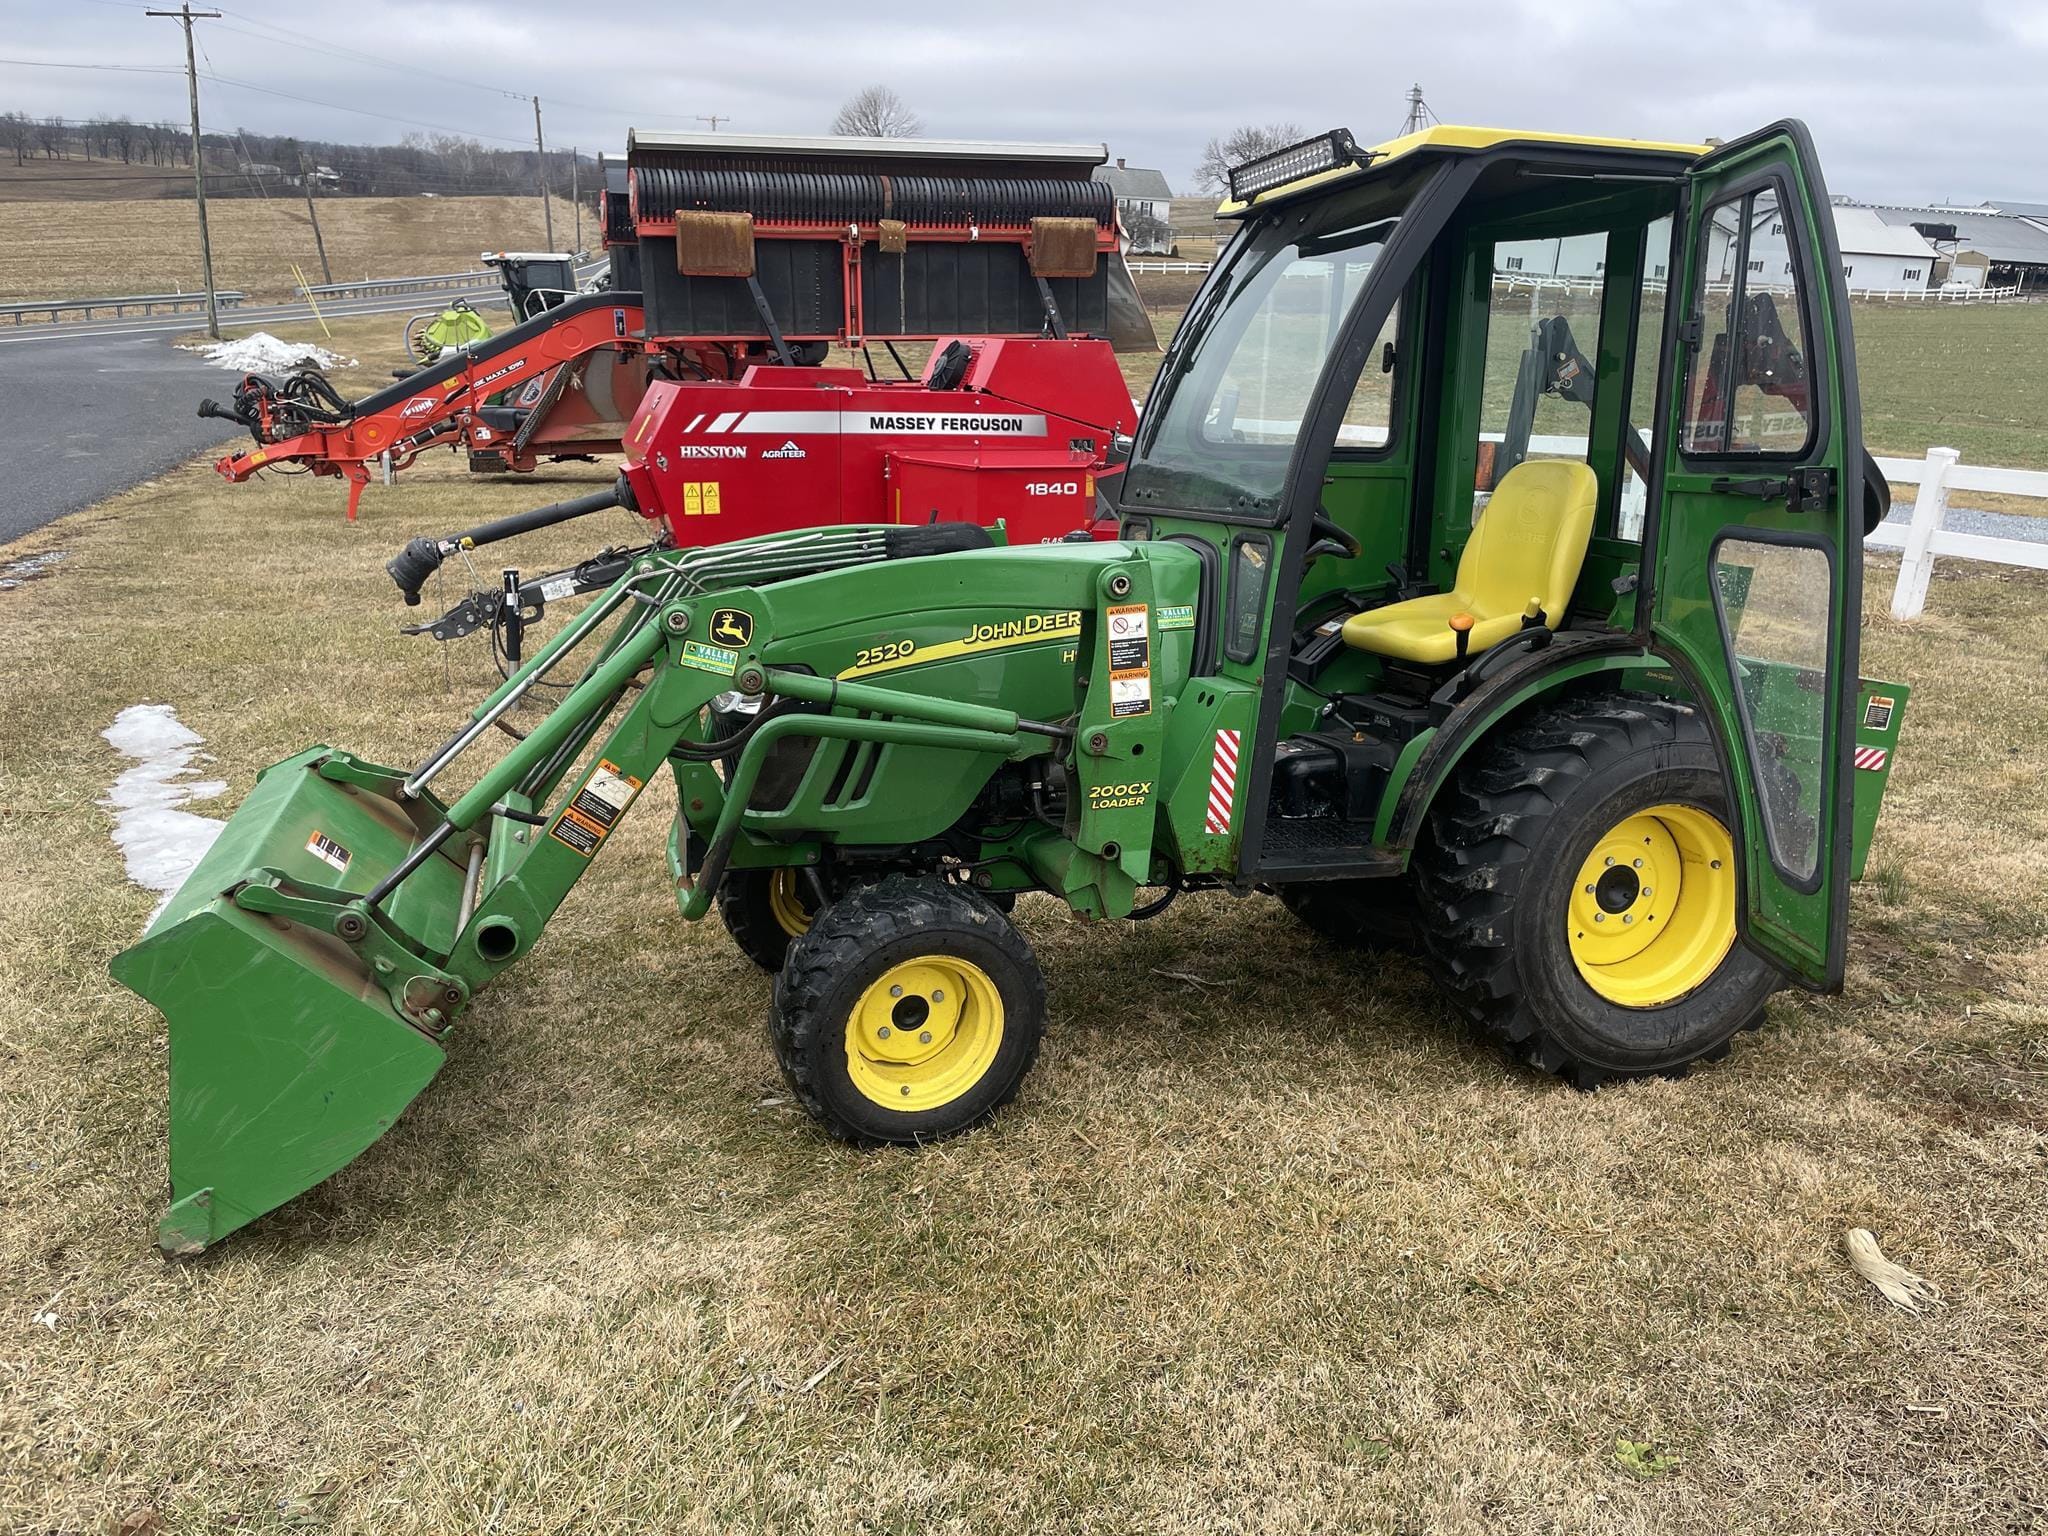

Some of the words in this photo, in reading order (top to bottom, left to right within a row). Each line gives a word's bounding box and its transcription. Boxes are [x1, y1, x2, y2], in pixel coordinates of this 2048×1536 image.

[485, 368, 508, 383] MAXX
[870, 416, 935, 431] MASSEY
[941, 417, 1022, 432] FERGUSON
[680, 446, 747, 459] HESSTON
[761, 450, 806, 459] AGRITEER
[1025, 482, 1078, 496] 1840
[1115, 605, 1146, 615] WARNING
[1163, 608, 1190, 617] VALLEY
[963, 621, 1023, 644] JOHN
[1024, 611, 1082, 634] DEER
[698, 646, 736, 660] VALLEY
[856, 639, 915, 668] 2520
[1117, 670, 1149, 680] WARNING
[1088, 782, 1152, 798] 200CX
[1092, 796, 1145, 809] LOADER
[575, 815, 602, 836] WARNING
